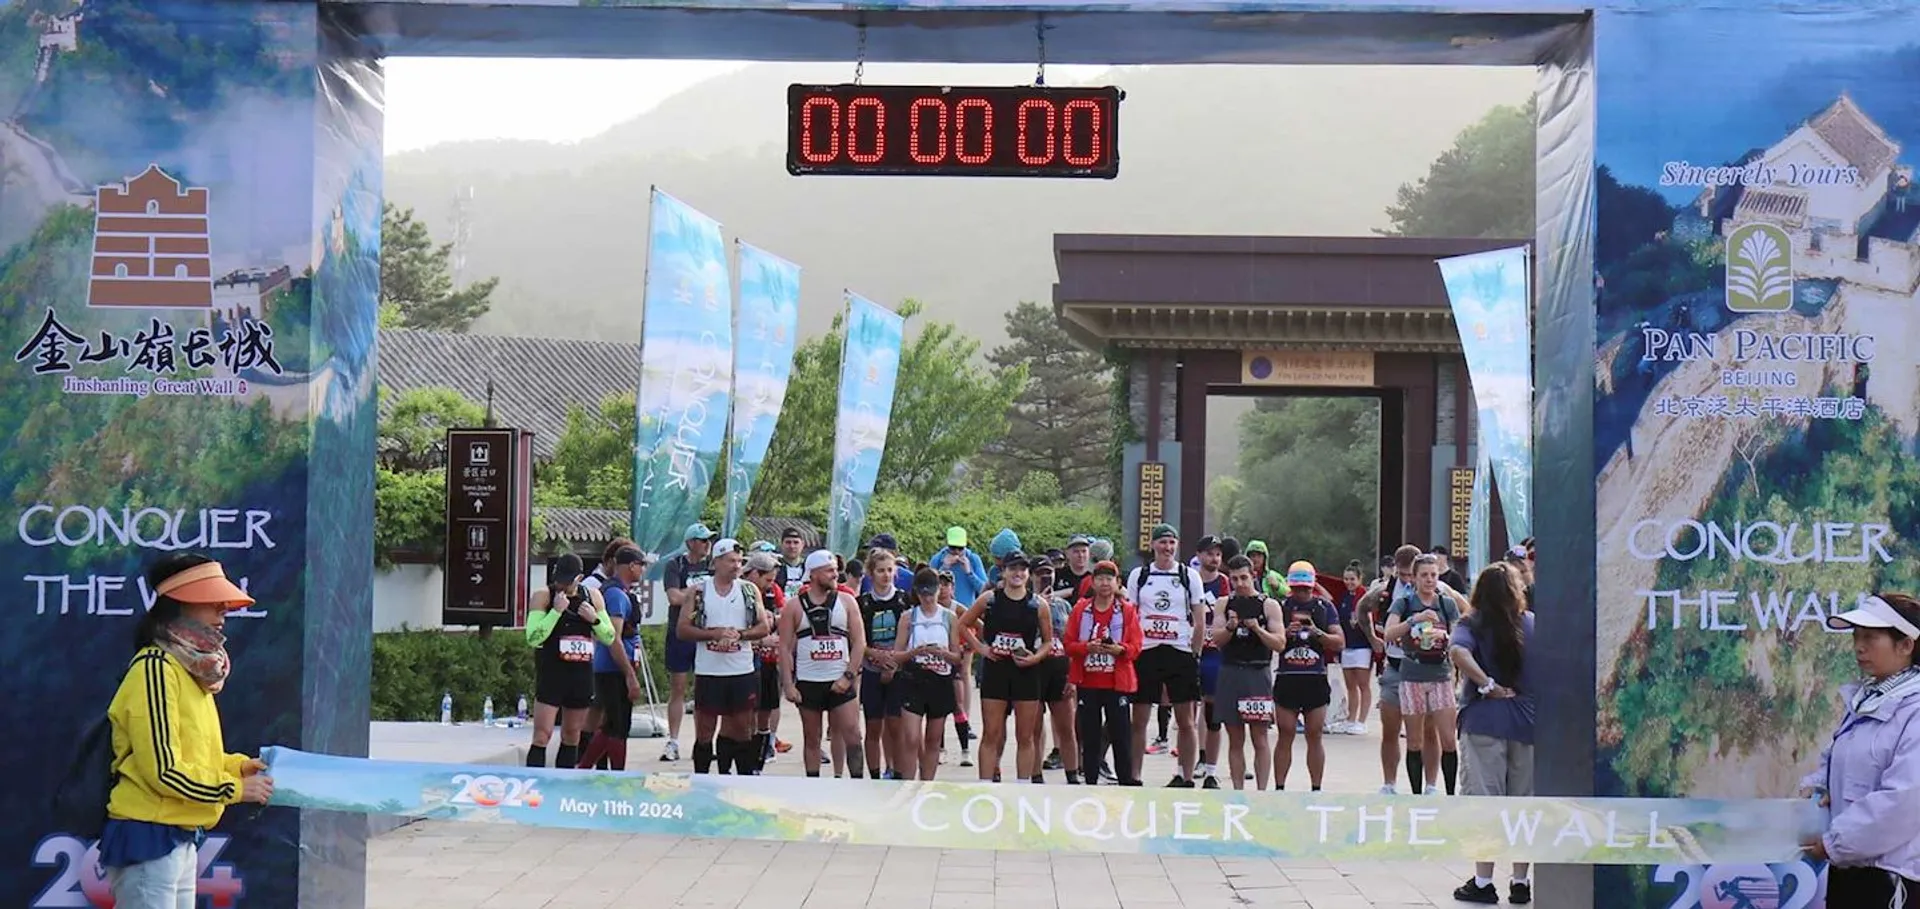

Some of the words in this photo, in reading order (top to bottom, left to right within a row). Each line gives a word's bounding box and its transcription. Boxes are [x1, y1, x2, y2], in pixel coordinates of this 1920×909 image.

[1661, 161, 1776, 187] Sincerely
[1789, 163, 1859, 185] Yours
[1643, 328, 1716, 362] PAN
[1736, 329, 1876, 362] PACIFIC
[64, 377, 148, 396] Jinshanling
[154, 379, 196, 394] Great
[201, 378, 233, 394] Wall
[1722, 370, 1796, 387] BEIJING
[1655, 397, 1866, 420] 北京泛太平洋酒店
[18, 504, 275, 550] CONQUER
[1627, 517, 1893, 564] CONQUER
[23, 574, 134, 617] THE
[1634, 588, 1747, 631] THE
[1751, 591, 1873, 633] WAL
[818, 641, 836, 651] 518
[1246, 701, 1265, 712] 505
[451, 774, 542, 808] 2024
[559, 797, 598, 817] May
[603, 799, 633, 817] 11th
[639, 801, 684, 819] 2024
[911, 792, 1254, 842] CONQUER
[1306, 804, 1446, 845] THE
[1501, 808, 1675, 848] WALL
